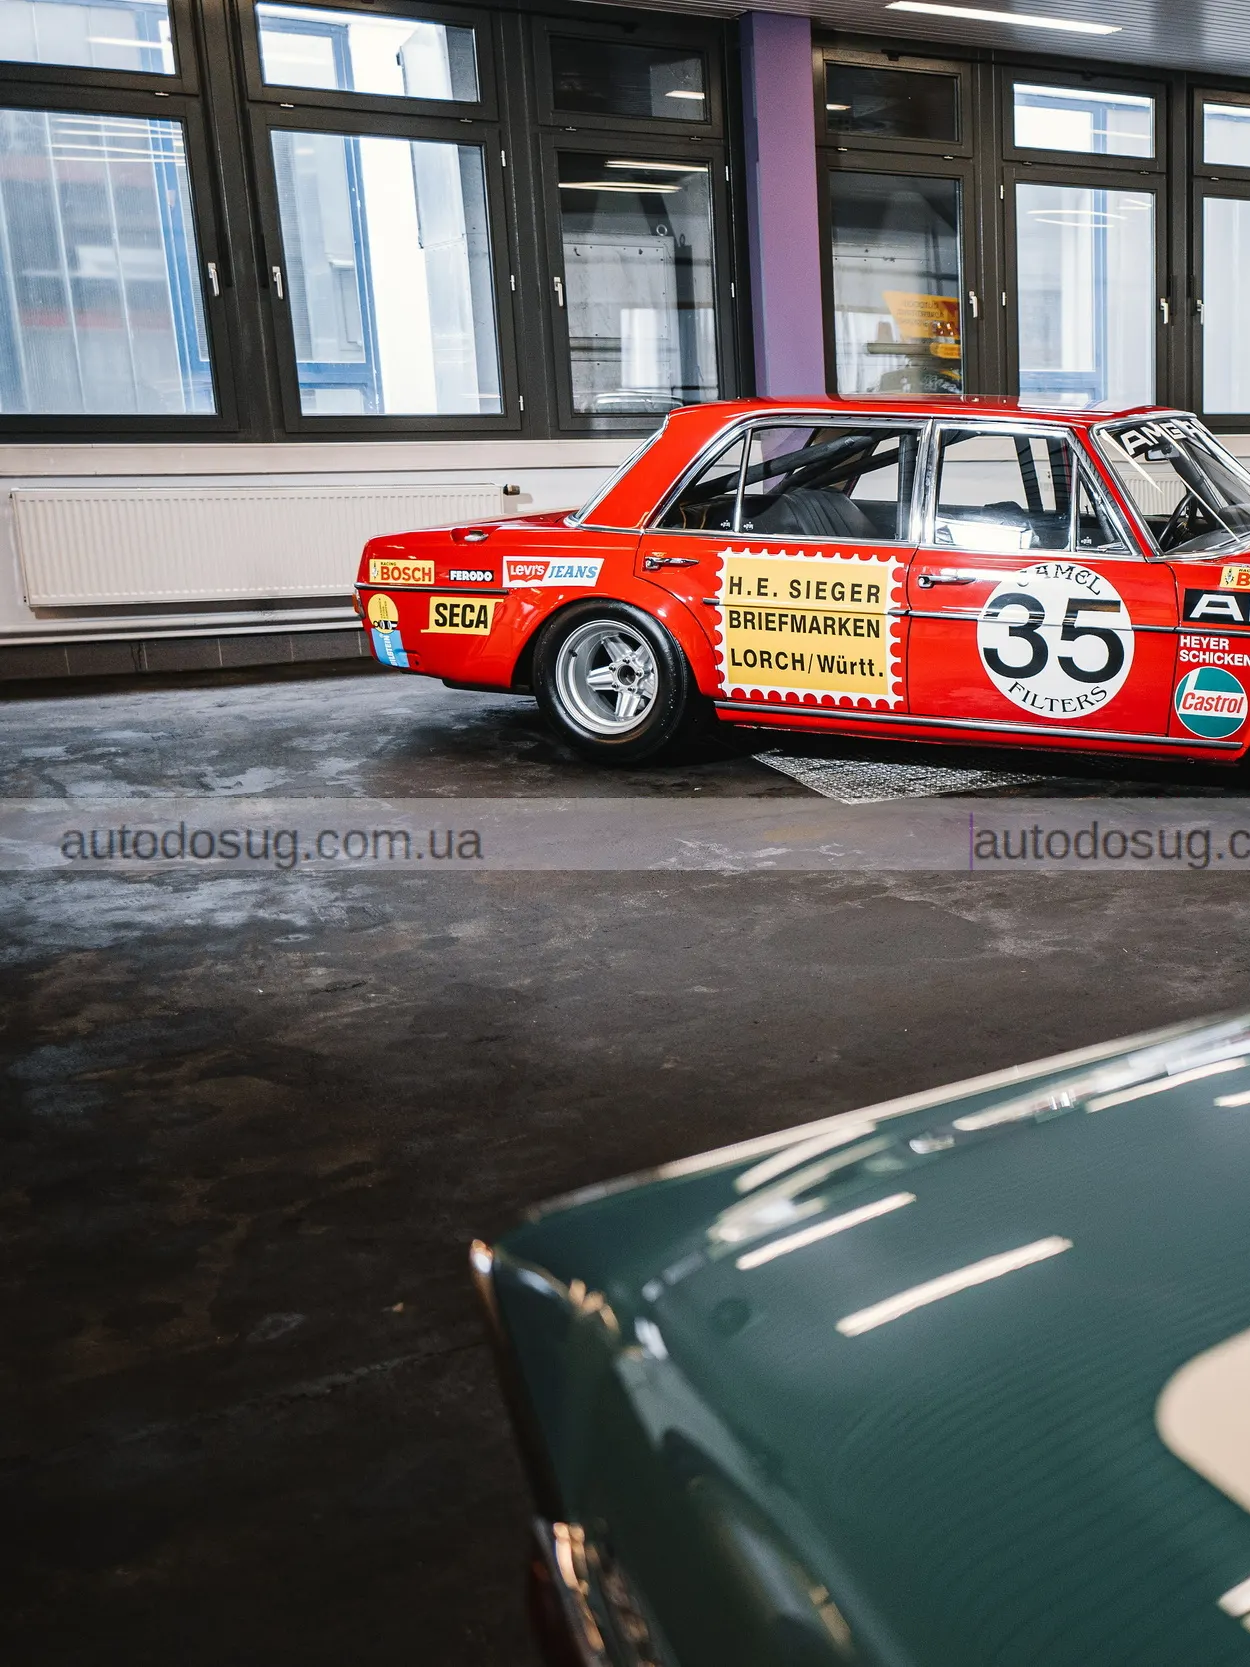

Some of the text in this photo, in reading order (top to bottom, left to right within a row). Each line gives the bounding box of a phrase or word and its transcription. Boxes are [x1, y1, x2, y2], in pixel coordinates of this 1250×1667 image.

[1120, 421, 1187, 456] AMG
[380, 566, 432, 582] BOSCH
[449, 569, 494, 582] FERODO
[548, 564, 598, 579] JEANS
[728, 575, 881, 604] H.E. SIEGER
[434, 602, 489, 629] SECA
[728, 609, 881, 639] BRIEFMARKEN
[982, 592, 1125, 684] 35
[1179, 634, 1230, 651] HEYER
[730, 647, 884, 678] LORCH/Württ.
[1007, 681, 1108, 713] FILTERS
[1181, 691, 1245, 714] Castrol
